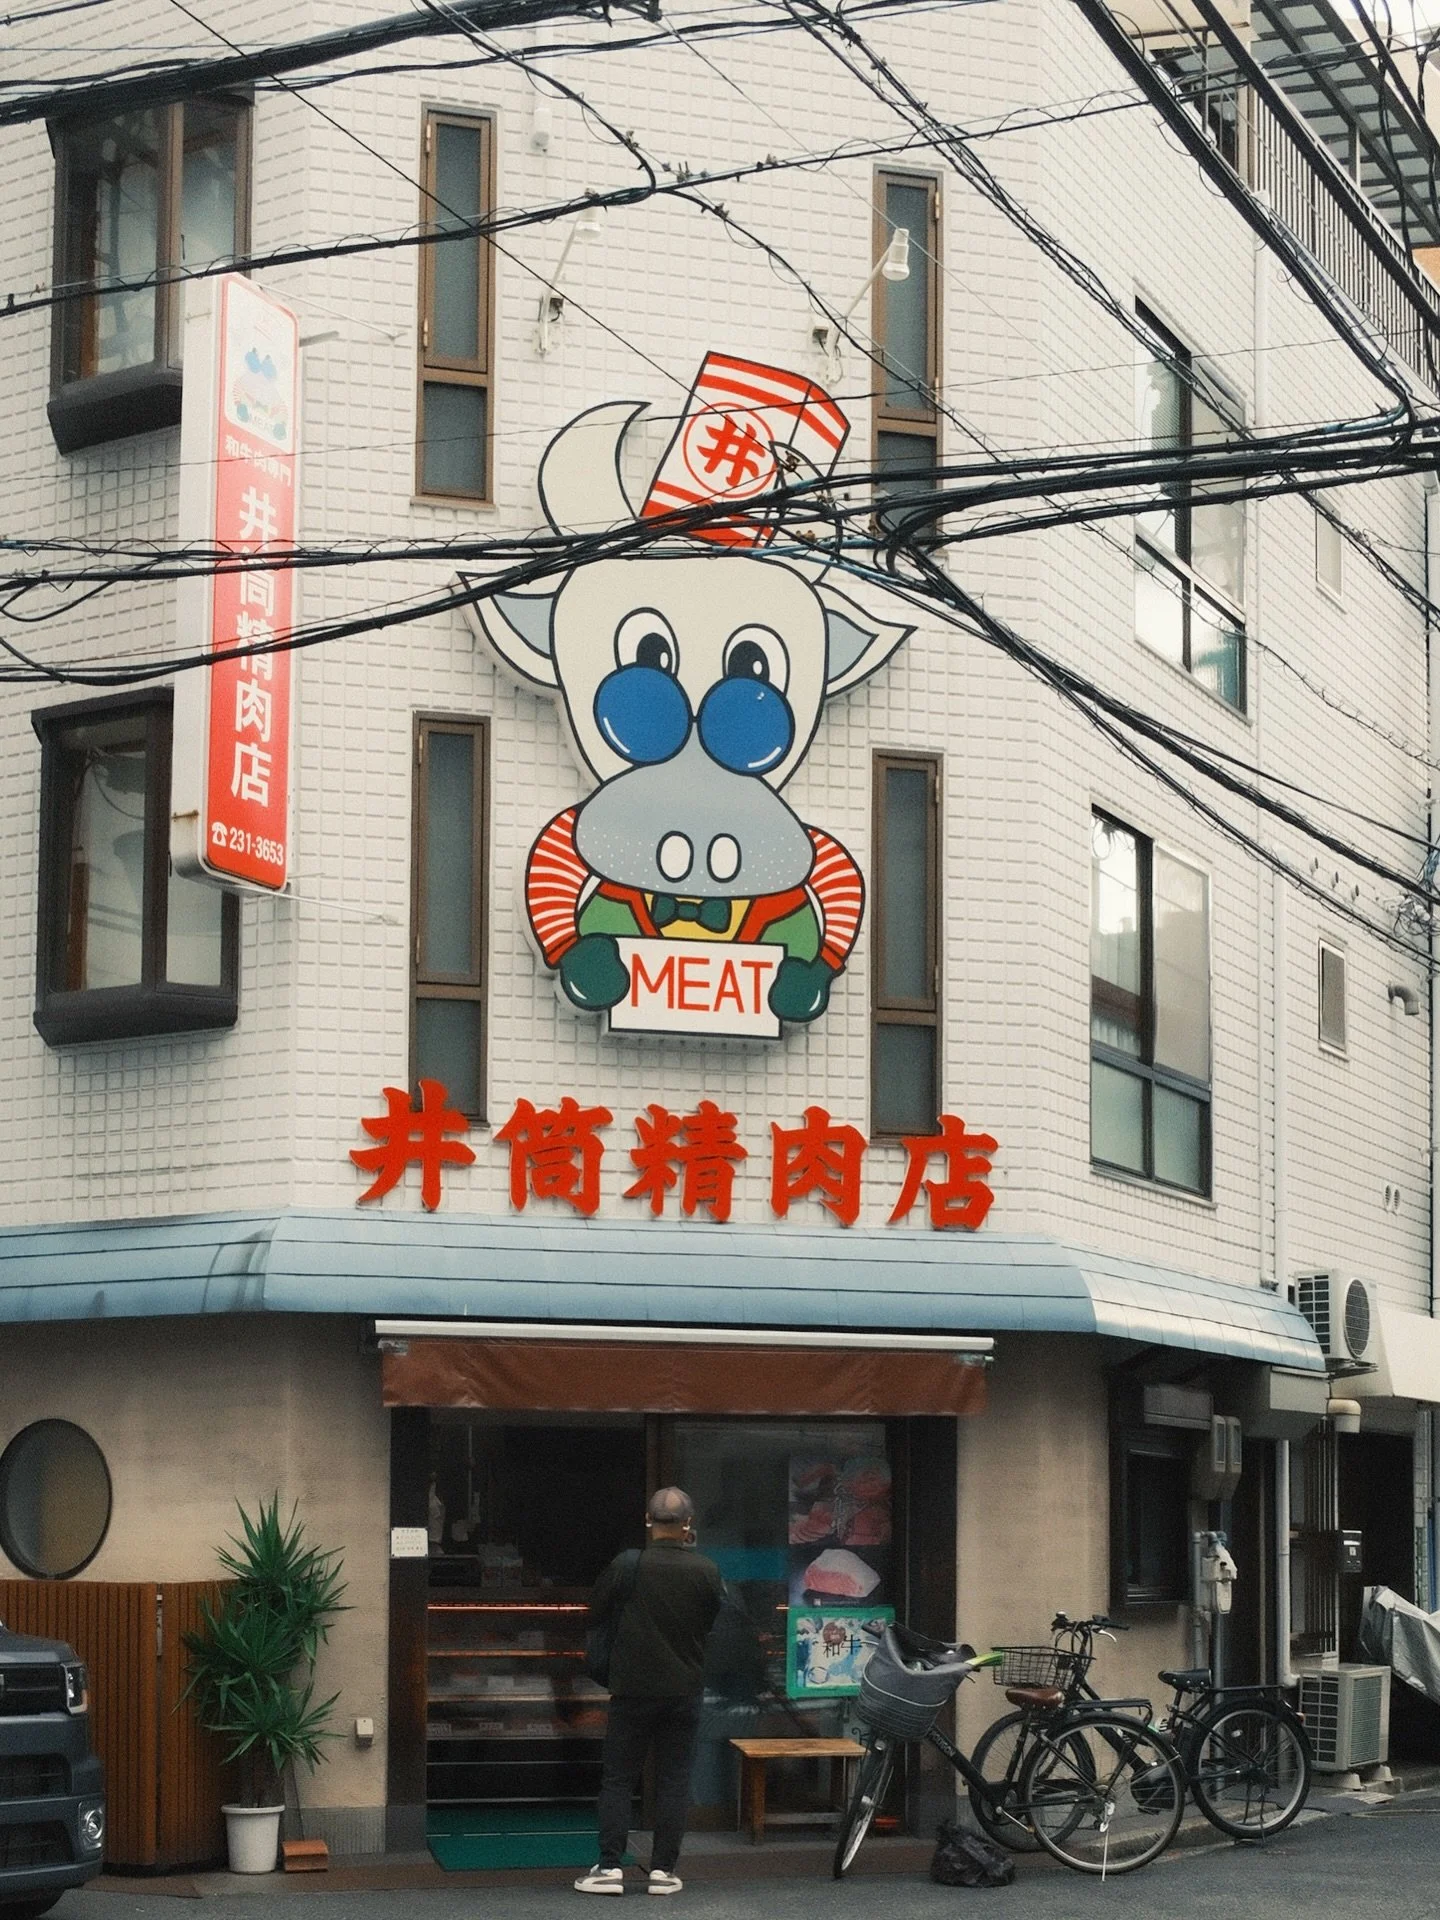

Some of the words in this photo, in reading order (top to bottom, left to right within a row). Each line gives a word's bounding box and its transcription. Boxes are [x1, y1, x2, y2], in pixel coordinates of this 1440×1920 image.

[696, 413, 766, 487] 井
[229, 826, 284, 866] 231-3653
[631, 953, 773, 1014] MEAT
[350, 1079, 999, 1232] 井筒精肉店
